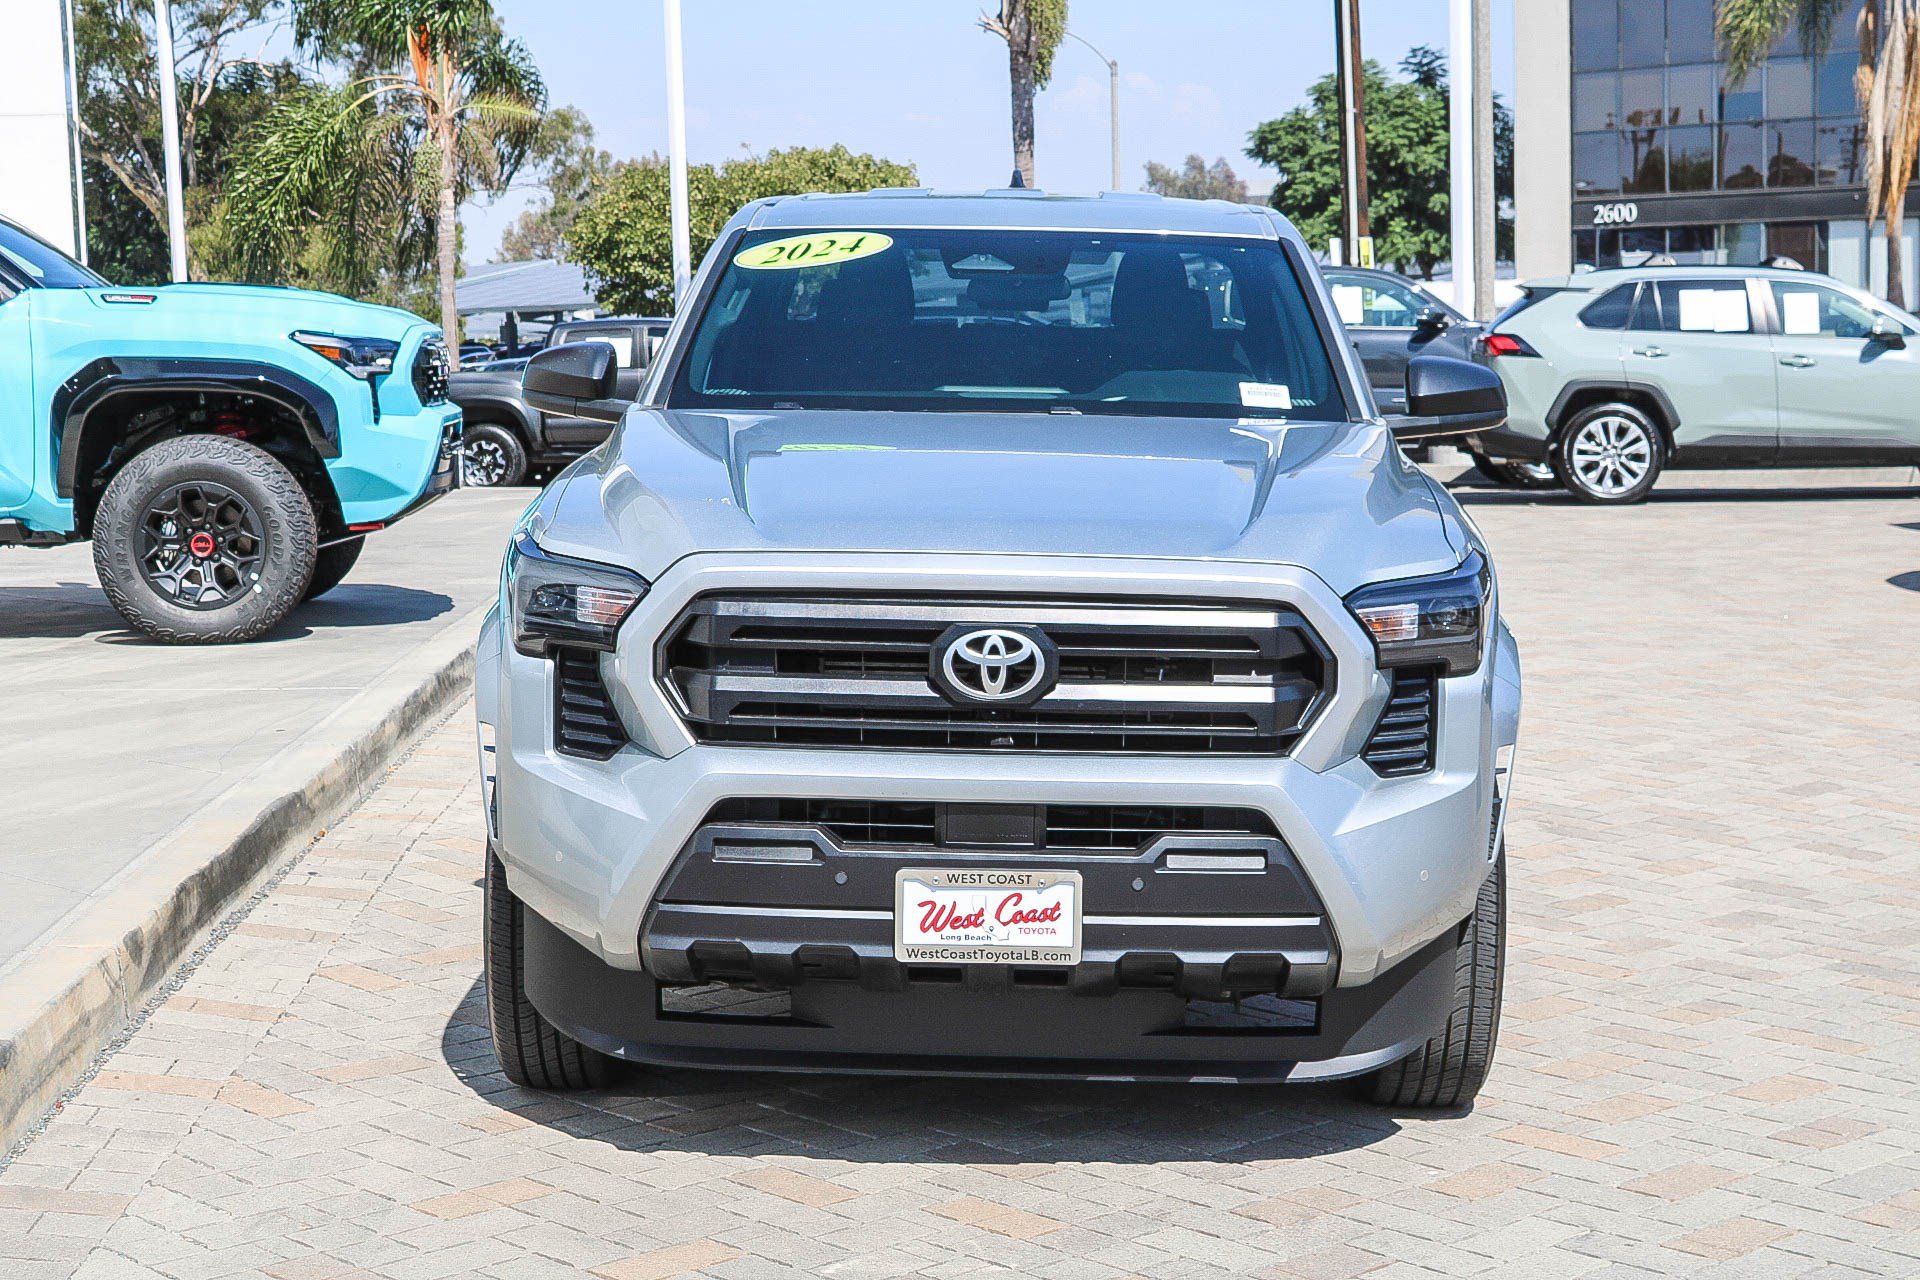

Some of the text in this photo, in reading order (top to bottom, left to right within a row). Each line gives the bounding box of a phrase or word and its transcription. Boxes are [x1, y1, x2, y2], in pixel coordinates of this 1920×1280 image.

[1593, 203, 1638, 224] 2600
[759, 236, 866, 265] 2024
[114, 477, 159, 583] WRANGLER
[947, 873, 1033, 885] WEST COAST
[917, 892, 1062, 933] West Coast
[940, 933, 962, 942] Long
[1017, 927, 1057, 935] TOYOTA
[906, 948, 1072, 963] WestCoastToyotaLB.com
